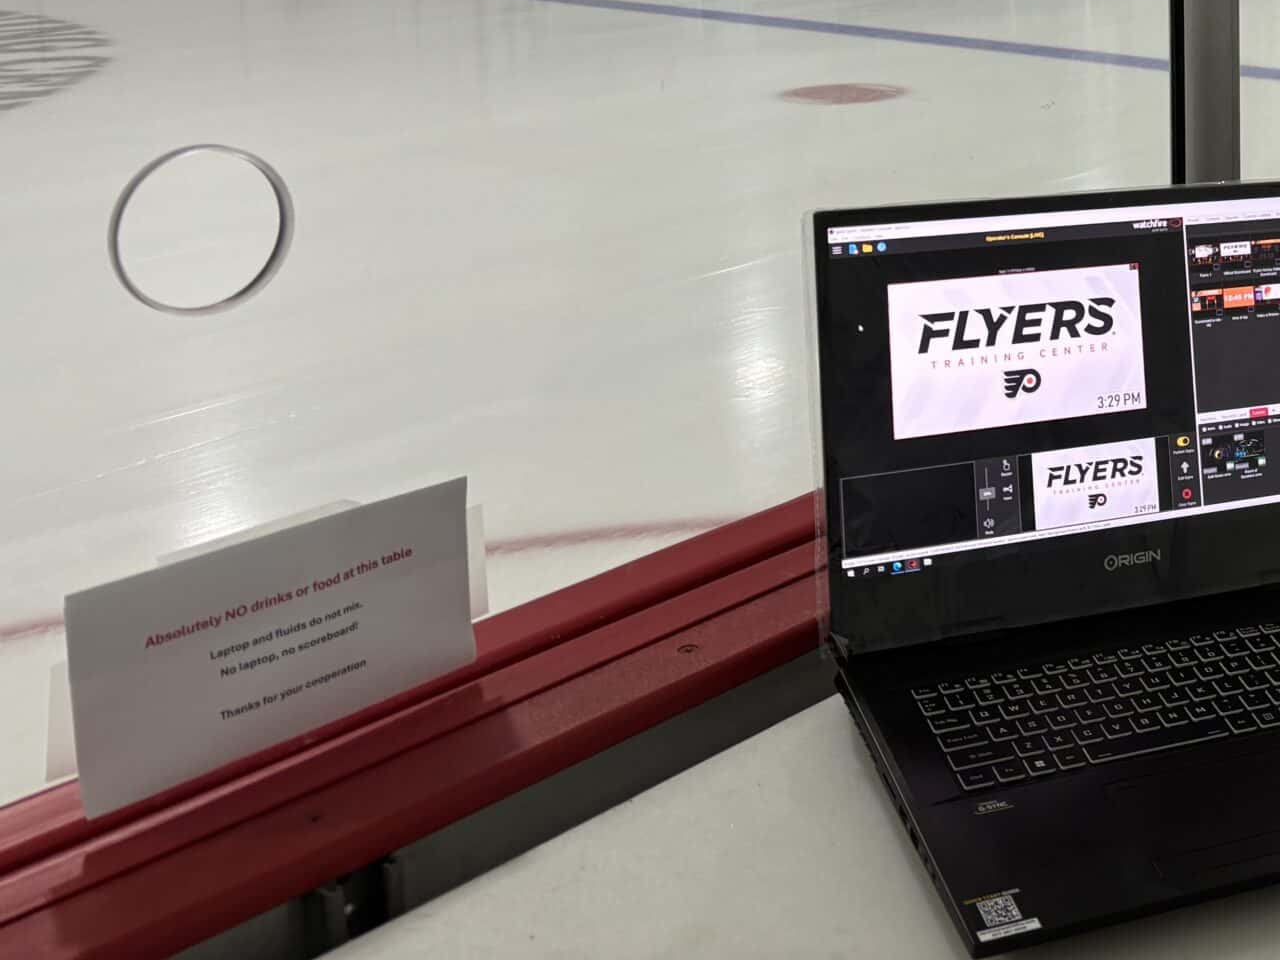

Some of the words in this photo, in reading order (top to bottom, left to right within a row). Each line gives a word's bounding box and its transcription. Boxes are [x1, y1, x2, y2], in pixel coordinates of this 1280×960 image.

[918, 297, 1116, 354] FLYERS
[931, 351, 1025, 369] TRAINING
[1039, 342, 1108, 358] CENTER
[1097, 393, 1120, 409] 3:29
[1123, 392, 1141, 406] PM
[1047, 455, 1144, 488] FLYERS
[1104, 549, 1161, 571] ORIGIN
[145, 615, 222, 649] Absolutely
[225, 605, 248, 622] NO
[250, 591, 293, 613] drinks
[295, 585, 309, 598] or
[312, 572, 341, 592] food
[343, 567, 355, 581] at
[356, 559, 379, 575] this
[381, 547, 413, 566] table
[210, 639, 250, 660] Laptop
[252, 632, 273, 647] and
[275, 622, 307, 639] fluids
[309, 615, 322, 627] do
[324, 609, 341, 622] not
[342, 601, 363, 615] mix.
[220, 665, 237, 679] No
[238, 652, 280, 671] laptop,
[281, 647, 296, 657] no
[220, 699, 261, 721] Thanks
[262, 694, 278, 705] for
[279, 685, 303, 701] your
[304, 659, 367, 689] cooperation
